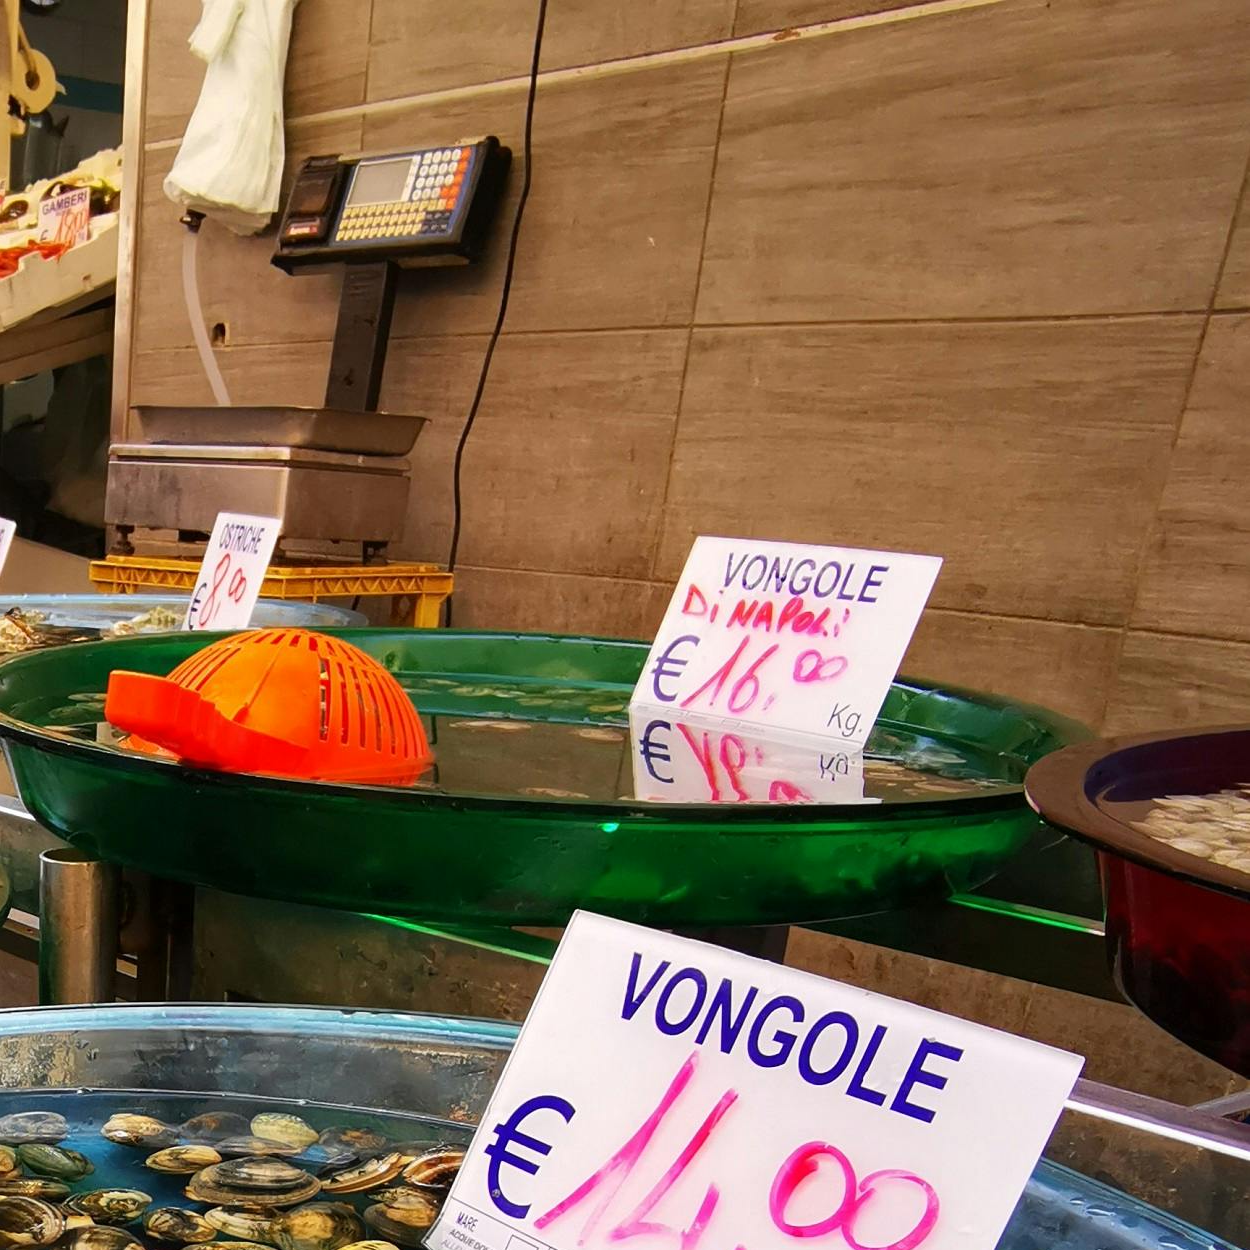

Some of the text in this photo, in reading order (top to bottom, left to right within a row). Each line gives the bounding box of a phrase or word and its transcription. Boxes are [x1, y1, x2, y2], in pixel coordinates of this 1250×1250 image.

[42, 190, 88, 215] GAMBERI
[219, 523, 265, 554] OSTRICHE
[723, 552, 889, 604] VONGOLE
[188, 582, 207, 631] €
[651, 634, 700, 702] €
[827, 702, 863, 738] Kg.
[620, 952, 964, 1123] VONGOLE
[484, 1095, 576, 1220] €
[449, 1228, 474, 1247] ACQUE
[455, 1211, 479, 1233] MARE
